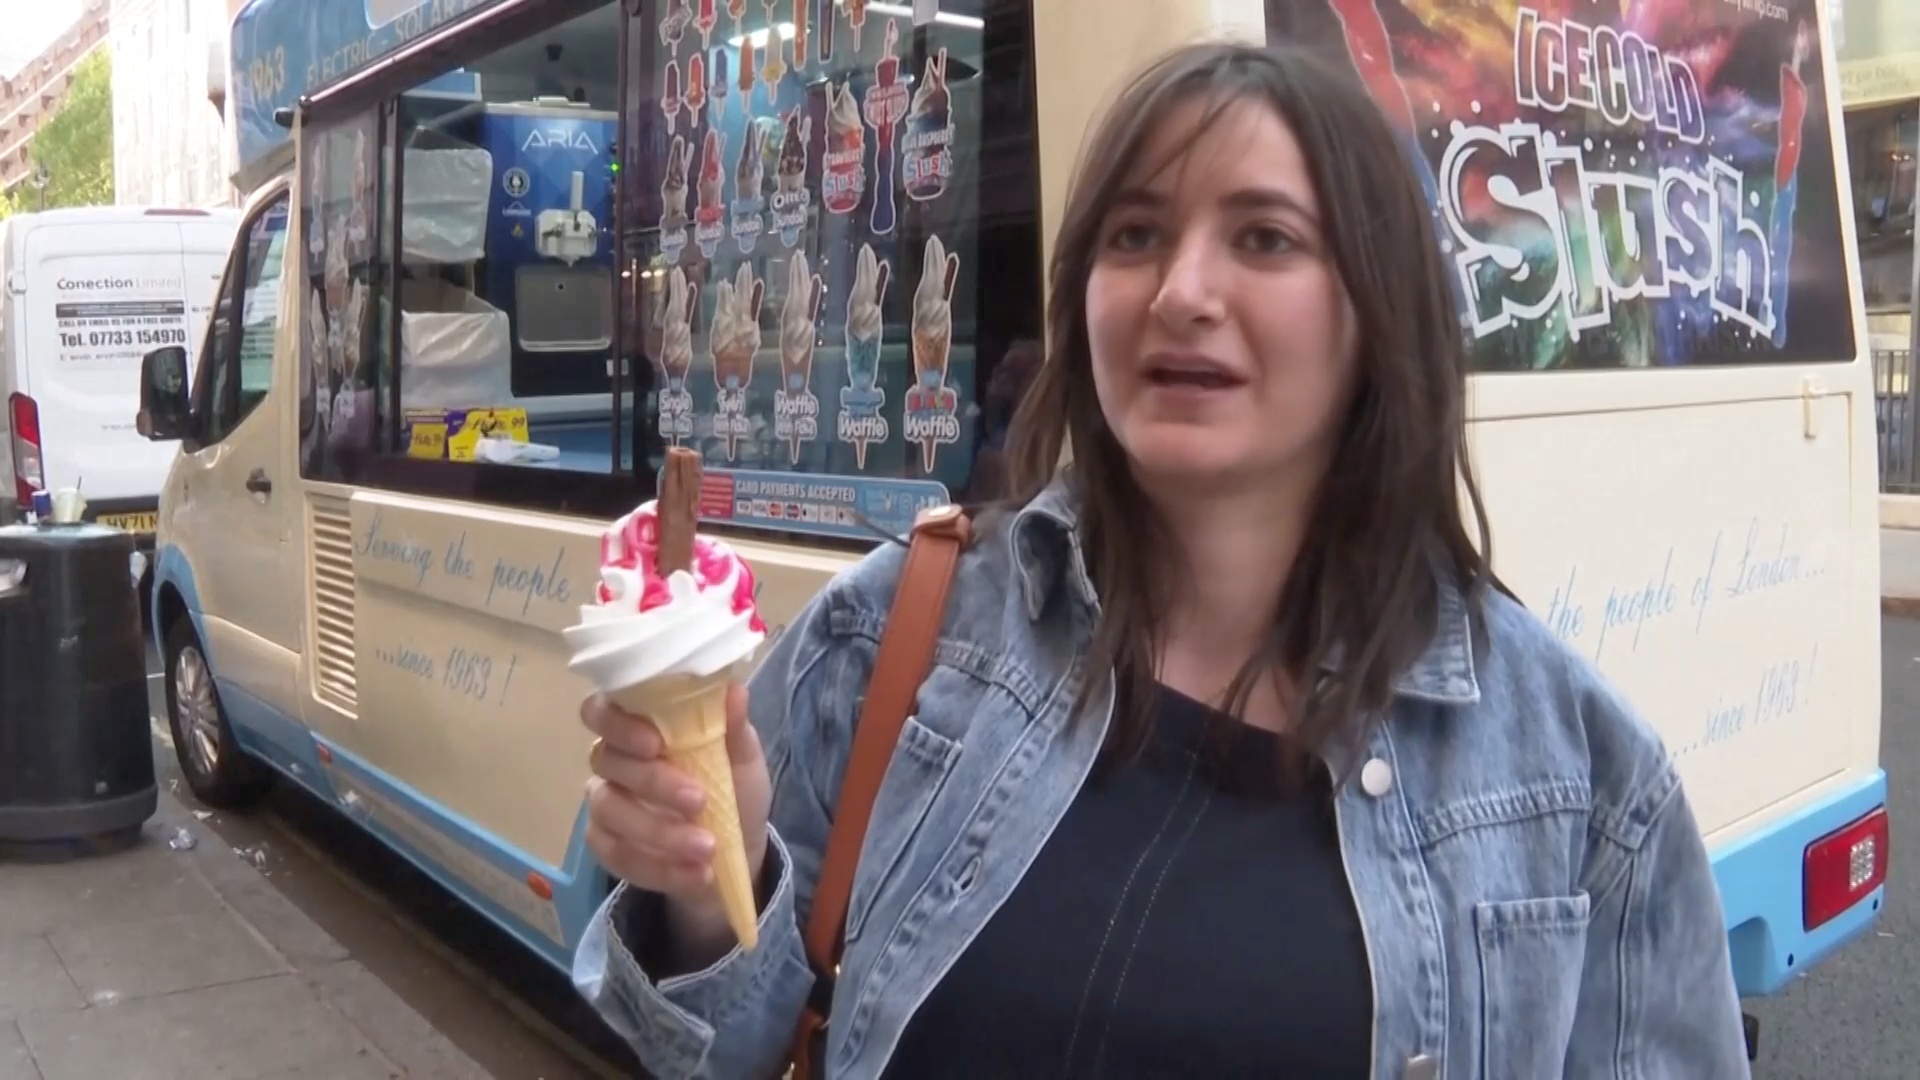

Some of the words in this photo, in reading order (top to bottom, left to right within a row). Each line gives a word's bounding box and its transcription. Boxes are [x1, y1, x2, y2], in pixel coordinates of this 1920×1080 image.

[306, 33, 376, 87] ELECTRIC
[395, 0, 454, 41] SOLAR
[521, 128, 598, 155] ARIA
[1439, 120, 1775, 340] Slush
[57, 276, 133, 290] Conection
[58, 319, 75, 328] CALL
[77, 319, 87, 327] OR
[89, 318, 109, 327] EMAIL
[123, 317, 136, 325] FOR
[59, 333, 87, 348] Tel.
[89, 330, 133, 347] 07733
[136, 328, 187, 345] 154970
[777, 395, 816, 415] Waffle
[840, 414, 885, 438] Waffle
[906, 414, 956, 438] Waffle
[736, 480, 759, 495] CARD
[761, 481, 806, 498] PAYMENTS
[807, 484, 856, 503] ACCEPTED
[354, 510, 432, 587] Serving
[445, 530, 476, 580] the
[487, 546, 572, 617] people
[1547, 564, 1585, 641] the
[1595, 545, 1678, 663] people
[1691, 528, 1724, 635] of
